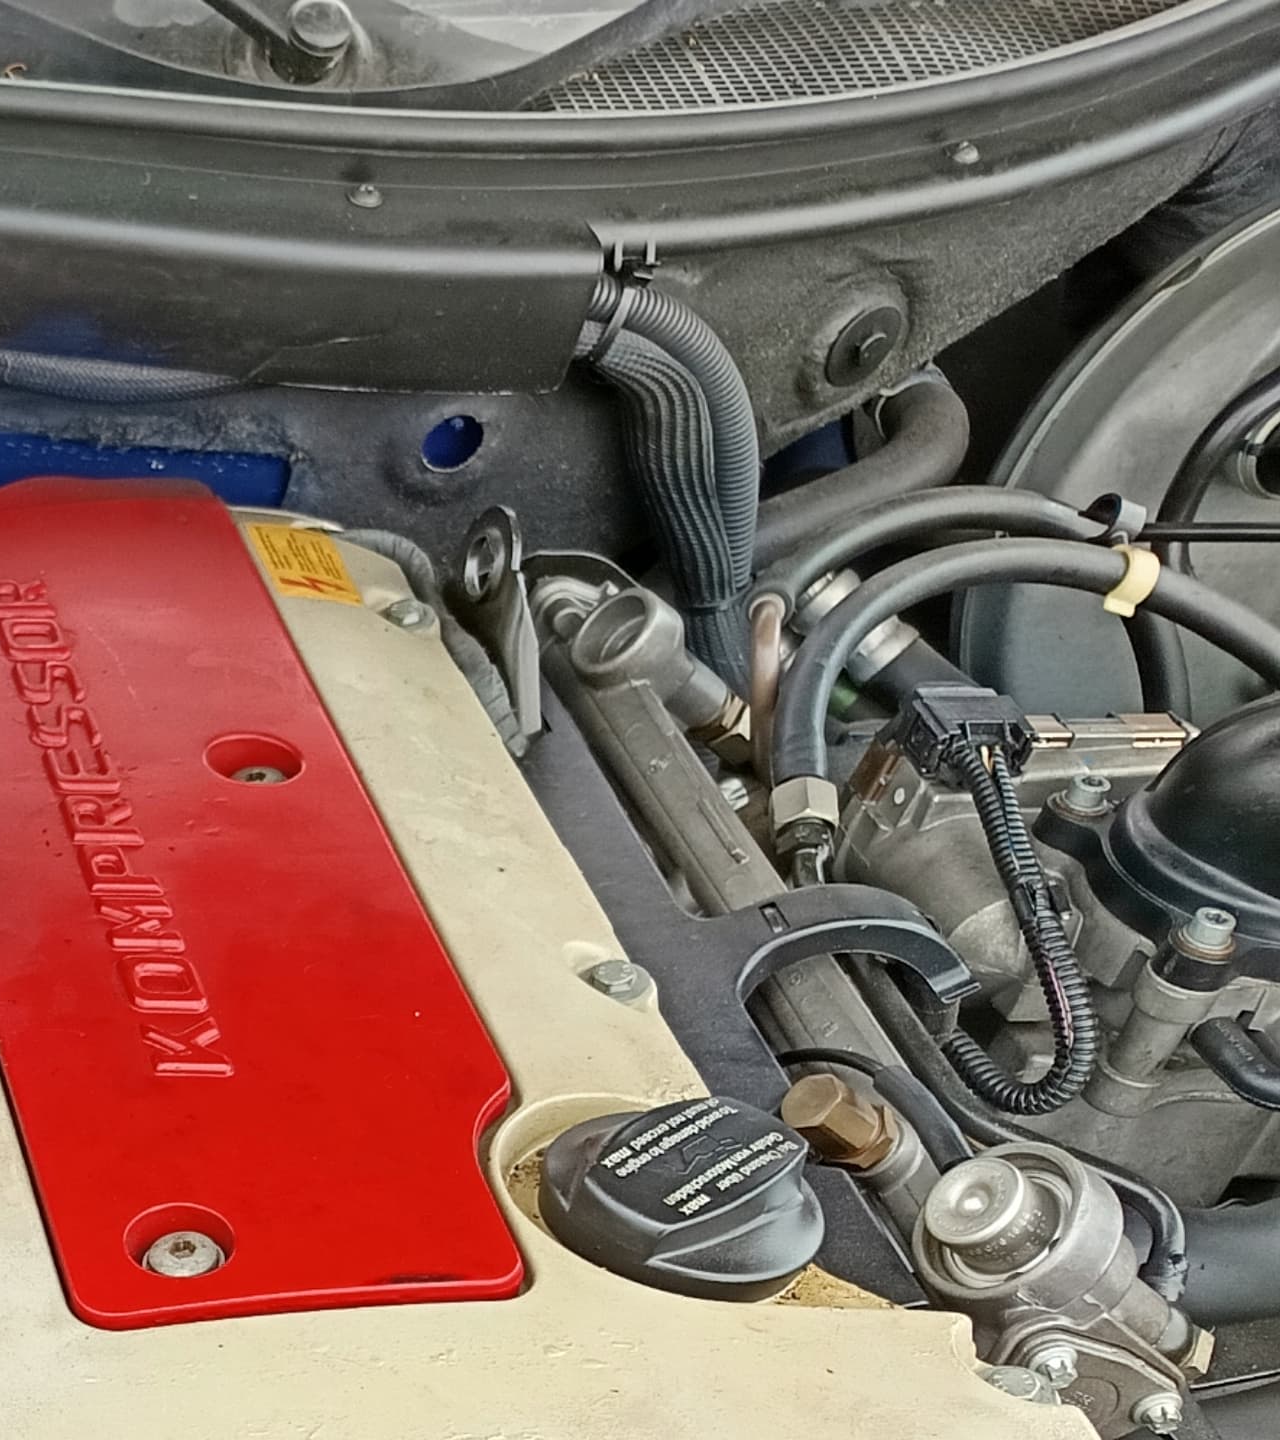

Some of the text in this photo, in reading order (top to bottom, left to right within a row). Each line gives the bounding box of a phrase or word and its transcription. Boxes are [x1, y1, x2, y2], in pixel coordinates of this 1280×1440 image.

[683, 1102, 709, 1118] must
[669, 1113, 685, 1128] not
[616, 1105, 739, 1177] To avoid damage to engine
[630, 1123, 668, 1150] exceed
[750, 1132, 784, 1150] Gefahr
[600, 1146, 632, 1168] max
[732, 1148, 752, 1161] von
[679, 1194, 711, 1216] max
